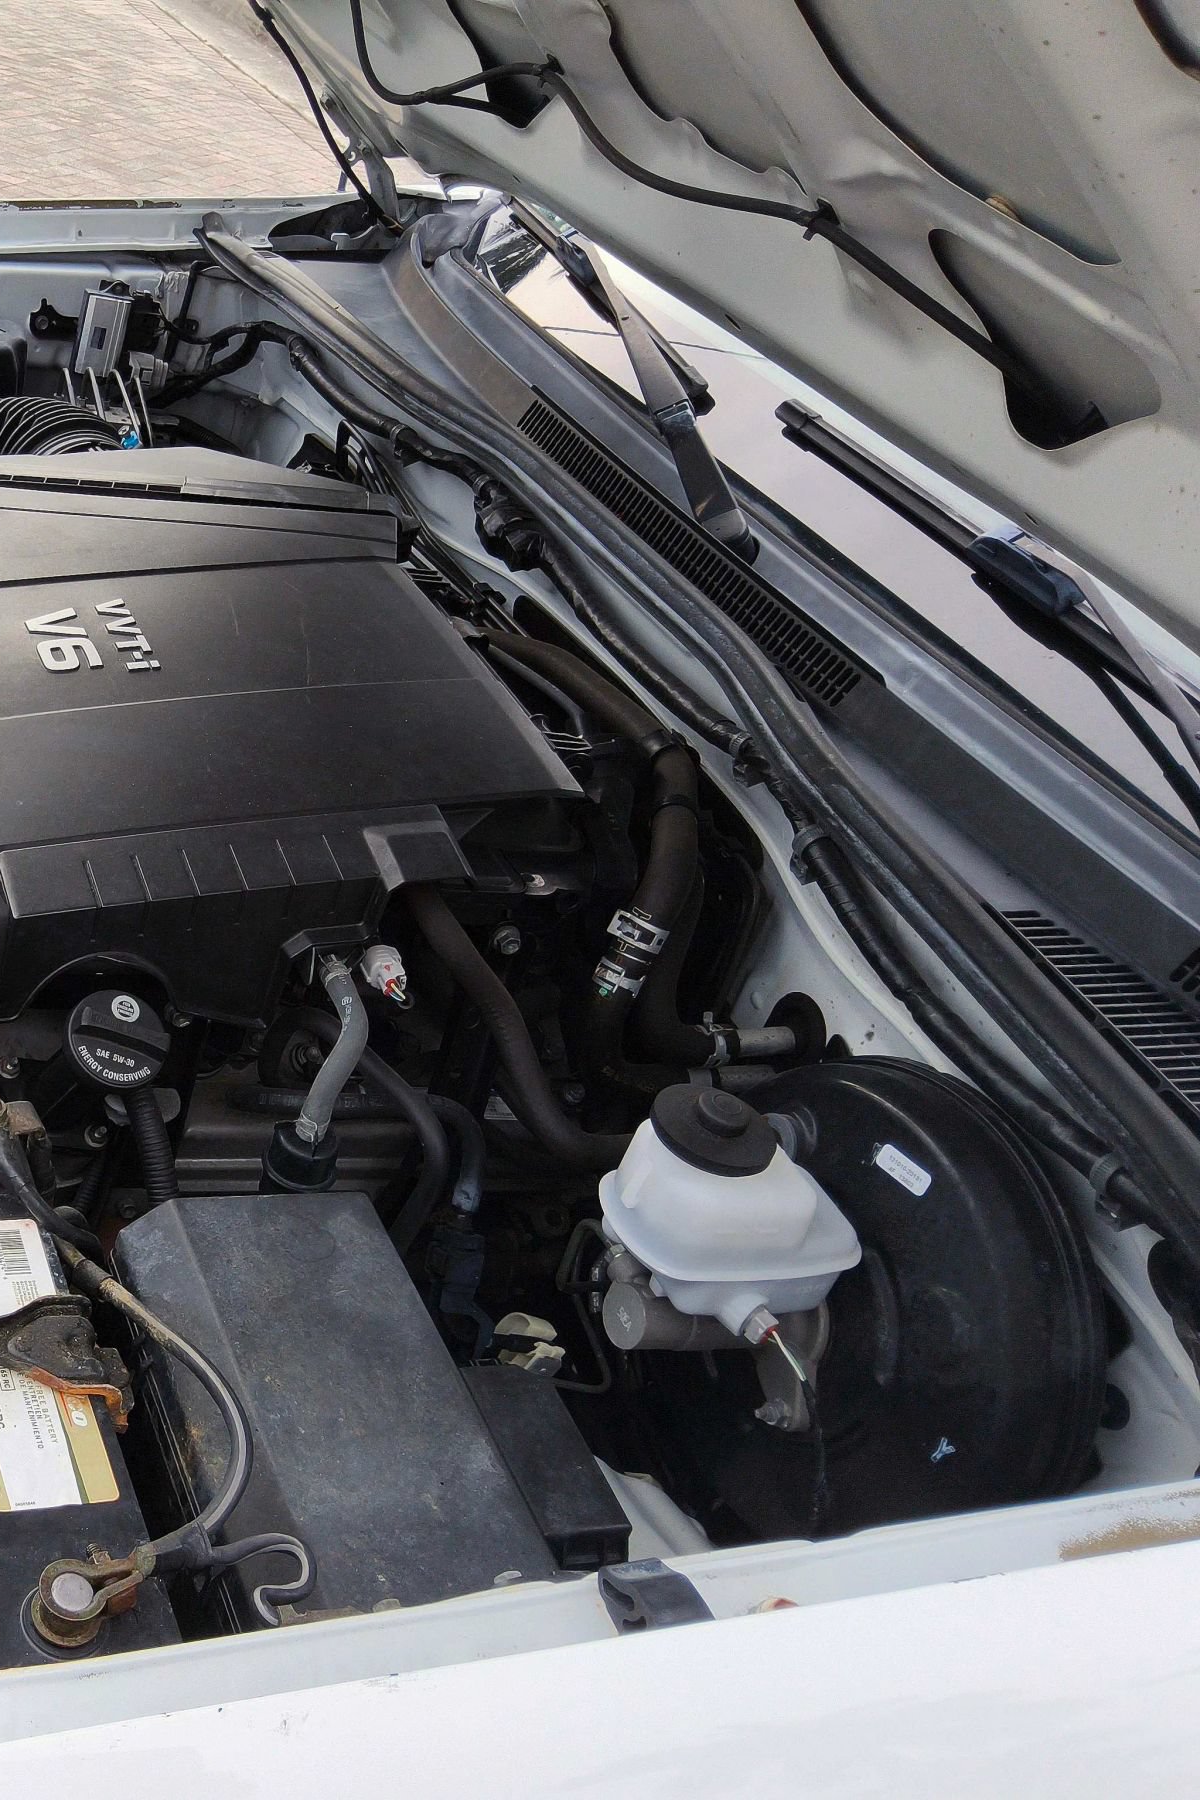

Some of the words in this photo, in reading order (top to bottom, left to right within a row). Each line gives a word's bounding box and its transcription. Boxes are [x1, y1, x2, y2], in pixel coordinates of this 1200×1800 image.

[25, 608, 103, 673] V6
[95, 598, 161, 673] VVT-i
[78, 1045, 103, 1072] ENERGY
[102, 1066, 151, 1081] CONSERVING
[96, 1048, 110, 1059] SAE
[112, 1054, 135, 1067] 5W-30
[1, 1379, 10, 1388] RC
[18, 1379, 27, 1387] DE
[25, 1381, 42, 1419] ENTRETIEN
[21, 1390, 44, 1449] MANTENIMIENTO
[34, 1385, 47, 1405] FREE
[41, 1408, 58, 1443] BATTERY
